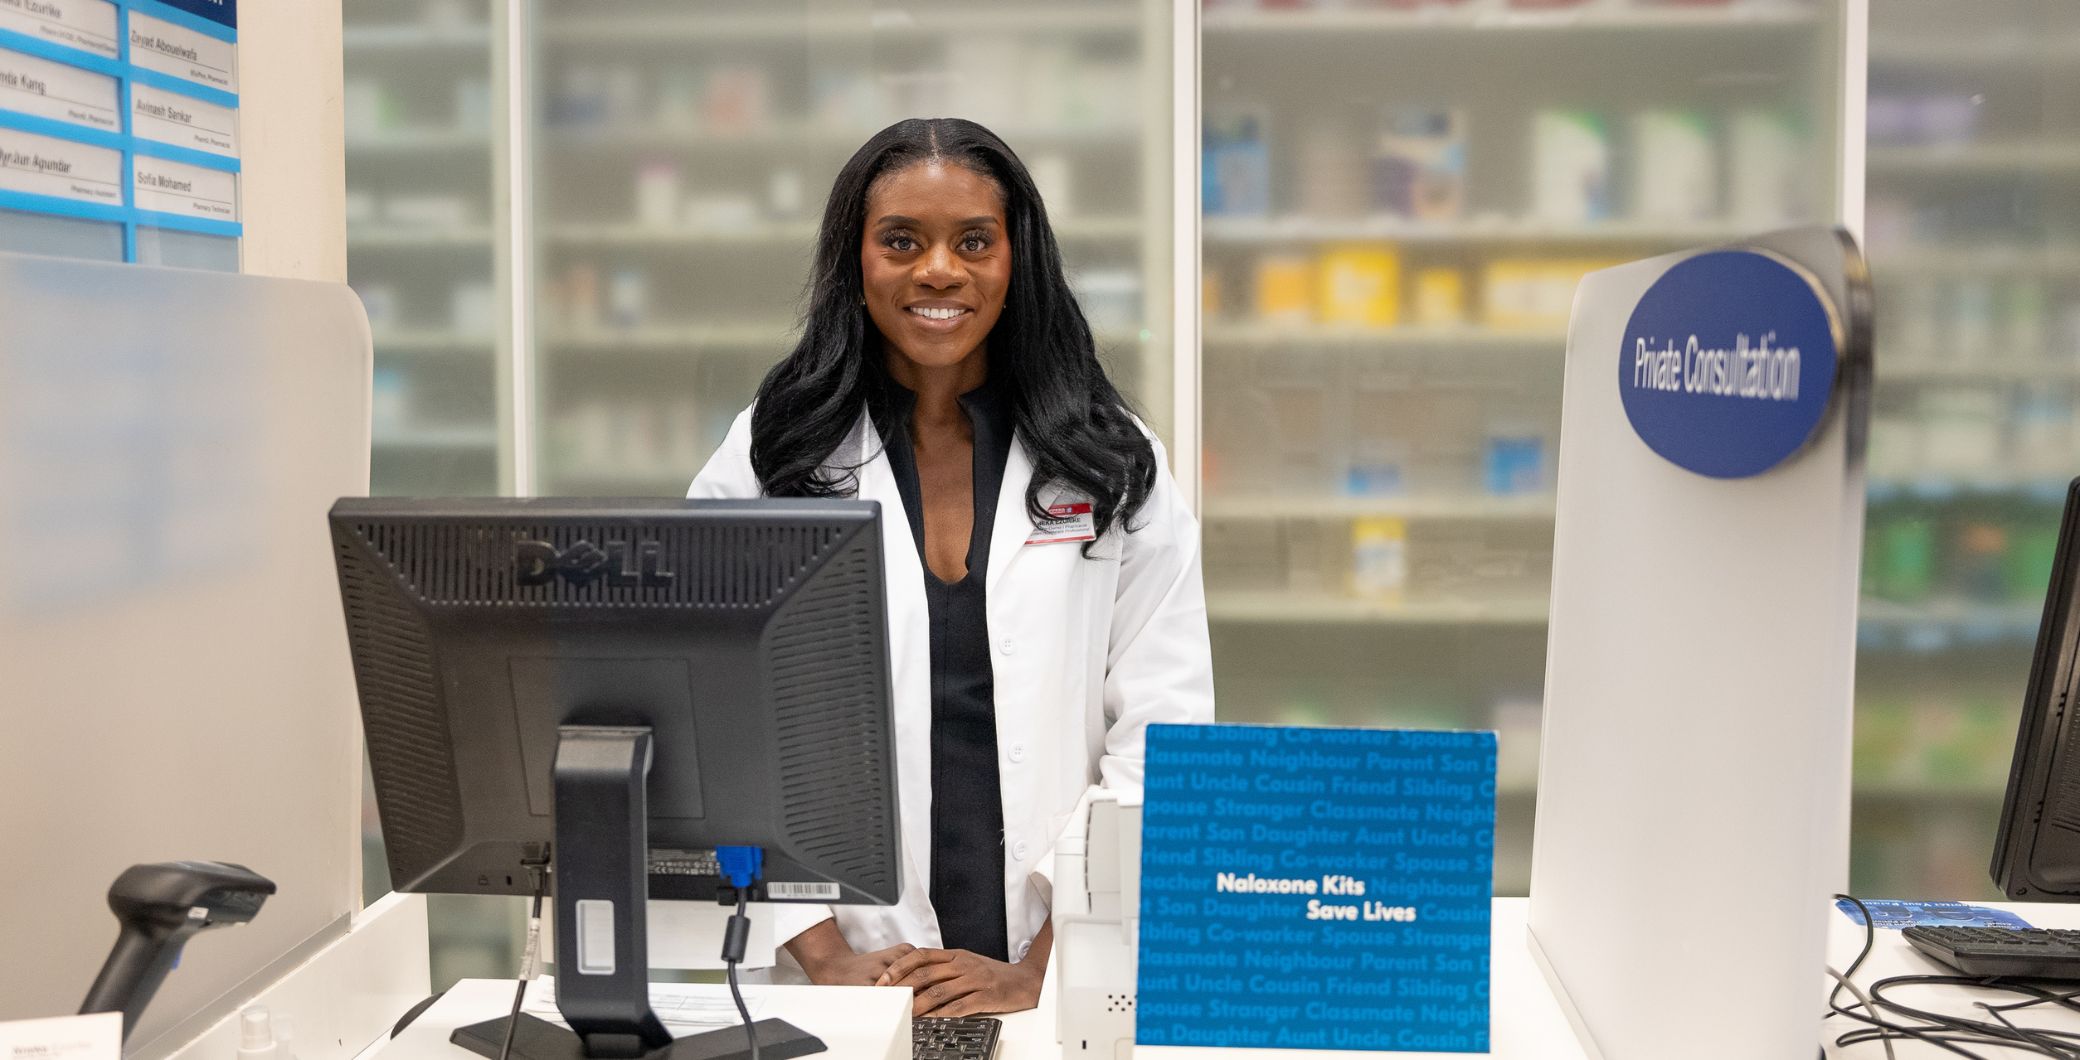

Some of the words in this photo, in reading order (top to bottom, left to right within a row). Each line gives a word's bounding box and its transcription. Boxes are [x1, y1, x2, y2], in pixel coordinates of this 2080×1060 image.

[137, 171, 156, 187] Sofia
[158, 175, 192, 192] Mohamed
[1634, 336, 1682, 392] Private
[1684, 330, 1801, 401] Consultation
[515, 540, 675, 588] DELL
[1149, 726, 1199, 741] riend
[1205, 726, 1278, 747] Sibling
[1284, 727, 1392, 746] Co-worker
[1398, 731, 1474, 750] Spouse
[1146, 747, 1244, 766] lassmate
[1251, 750, 1361, 772] Neighbour
[1366, 752, 1434, 771] Parent
[1440, 755, 1480, 772] Son
[1145, 773, 1185, 790] unt
[1190, 772, 1249, 790] Uncle
[1255, 773, 1325, 793] Cousin
[1332, 775, 1397, 795] Friend
[1402, 778, 1474, 802] Sibling
[1145, 799, 1208, 817] pouse
[1213, 798, 1304, 822] Stranger
[1311, 800, 1420, 821] Classmate
[1143, 824, 1200, 840] arent
[1207, 823, 1245, 841] Son
[1252, 824, 1348, 848] Daughter
[1354, 827, 1404, 846] Aunt
[1411, 828, 1469, 847] Uncle
[1142, 848, 1196, 865] riend
[1202, 848, 1274, 872] Sibling
[1280, 849, 1388, 869] Co-worker
[1393, 852, 1469, 874] Spouse
[1141, 871, 1211, 891] eacher
[1216, 872, 1318, 894] Naloxone
[1322, 874, 1366, 896] Kits
[1371, 878, 1480, 900] Neighbour
[1157, 897, 1197, 916] Son
[1203, 898, 1300, 923] Daughter
[1306, 899, 1358, 920] Save
[1363, 901, 1417, 922] Lives
[1422, 903, 1491, 922] Cousin
[1141, 922, 1200, 946] ibling
[1206, 923, 1316, 943] Co-worker
[1322, 926, 1397, 949] Spouse
[1402, 928, 1491, 951] Stranger
[1140, 948, 1238, 967] lassmate
[1245, 950, 1355, 973] Neighbour
[1361, 953, 1428, 971] Parent
[1435, 954, 1473, 972] Son
[1139, 975, 1179, 991] unt
[1185, 974, 1243, 991] Uncle
[1250, 975, 1321, 993] Cousin
[1327, 976, 1392, 995] Friend
[1398, 978, 1468, 1002] Sibling
[1140, 1001, 1203, 1018] pouse
[1209, 1000, 1300, 1023] Stranger
[1306, 1002, 1415, 1022] Classmate
[1139, 1028, 1165, 1042] on
[1172, 1023, 1270, 1046] Daughter
[1275, 1026, 1326, 1045] Aunt
[1333, 1028, 1391, 1046] Uncle
[1398, 1029, 1468, 1047] Cousin
